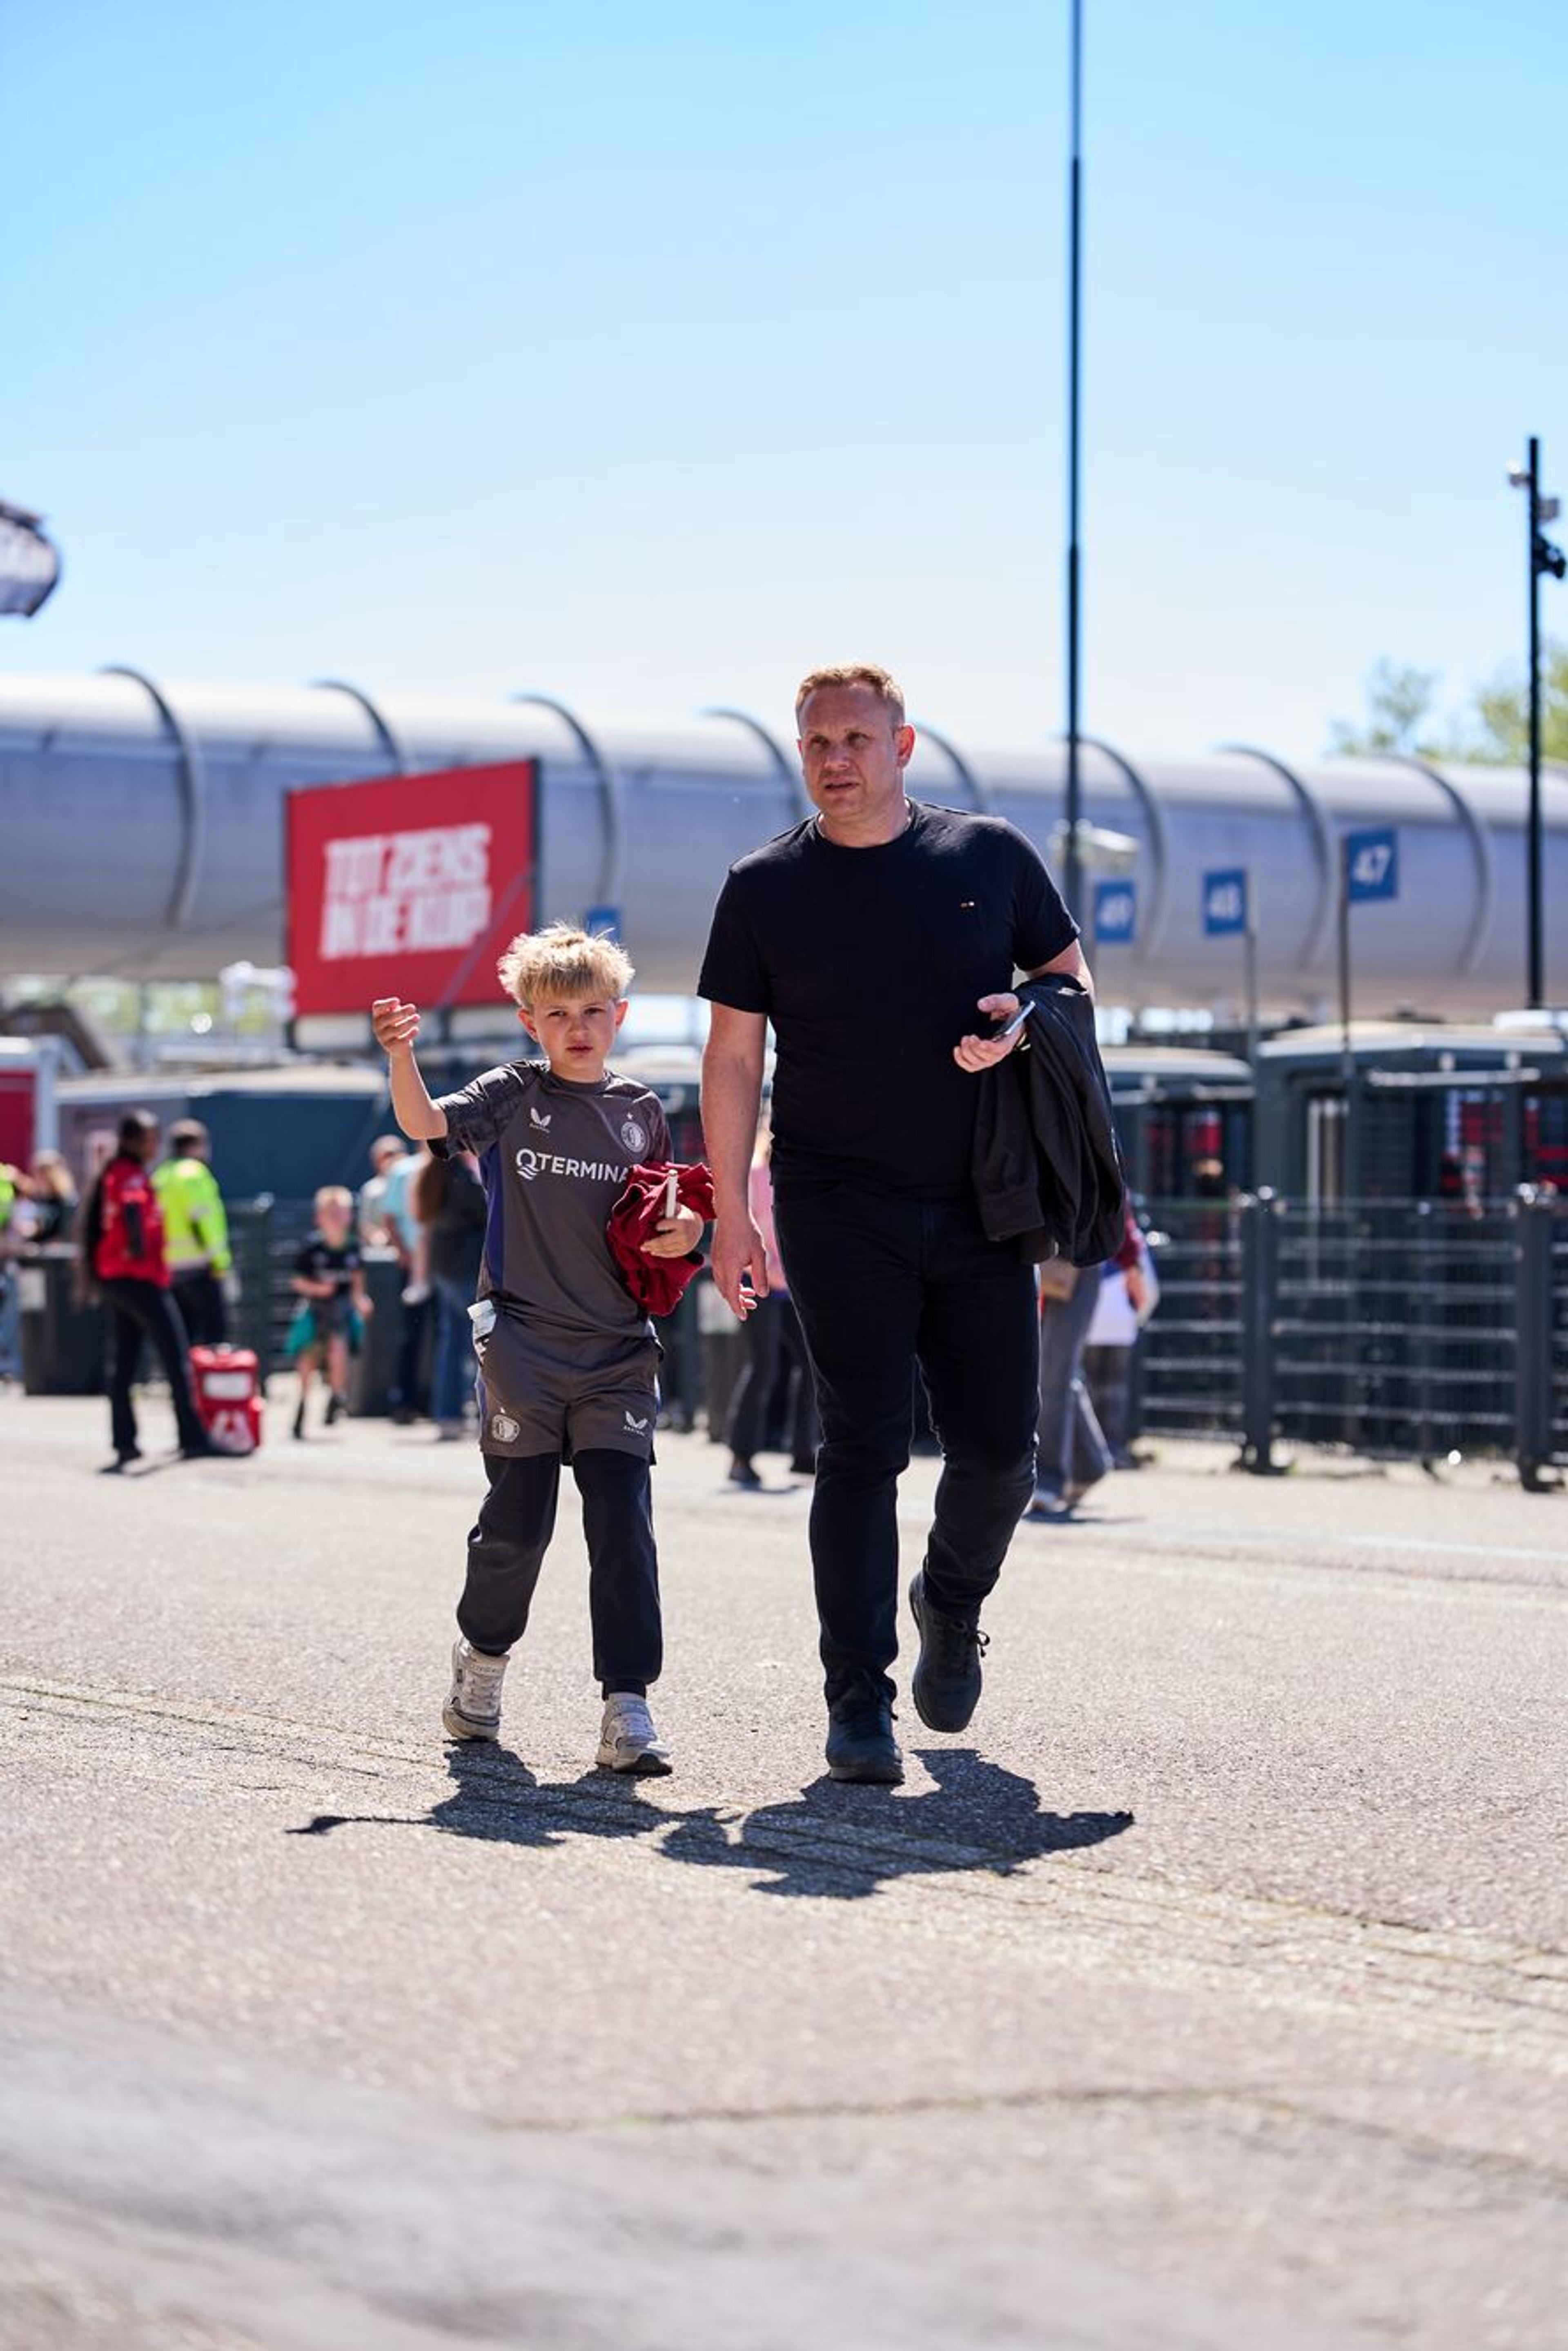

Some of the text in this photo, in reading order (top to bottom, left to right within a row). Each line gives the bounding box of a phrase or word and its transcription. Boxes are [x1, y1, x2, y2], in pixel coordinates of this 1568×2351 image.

[325, 823, 491, 899] TOT ZIENS
[1352, 845, 1392, 886] 47
[321, 885, 491, 960] IN DE KUIP
